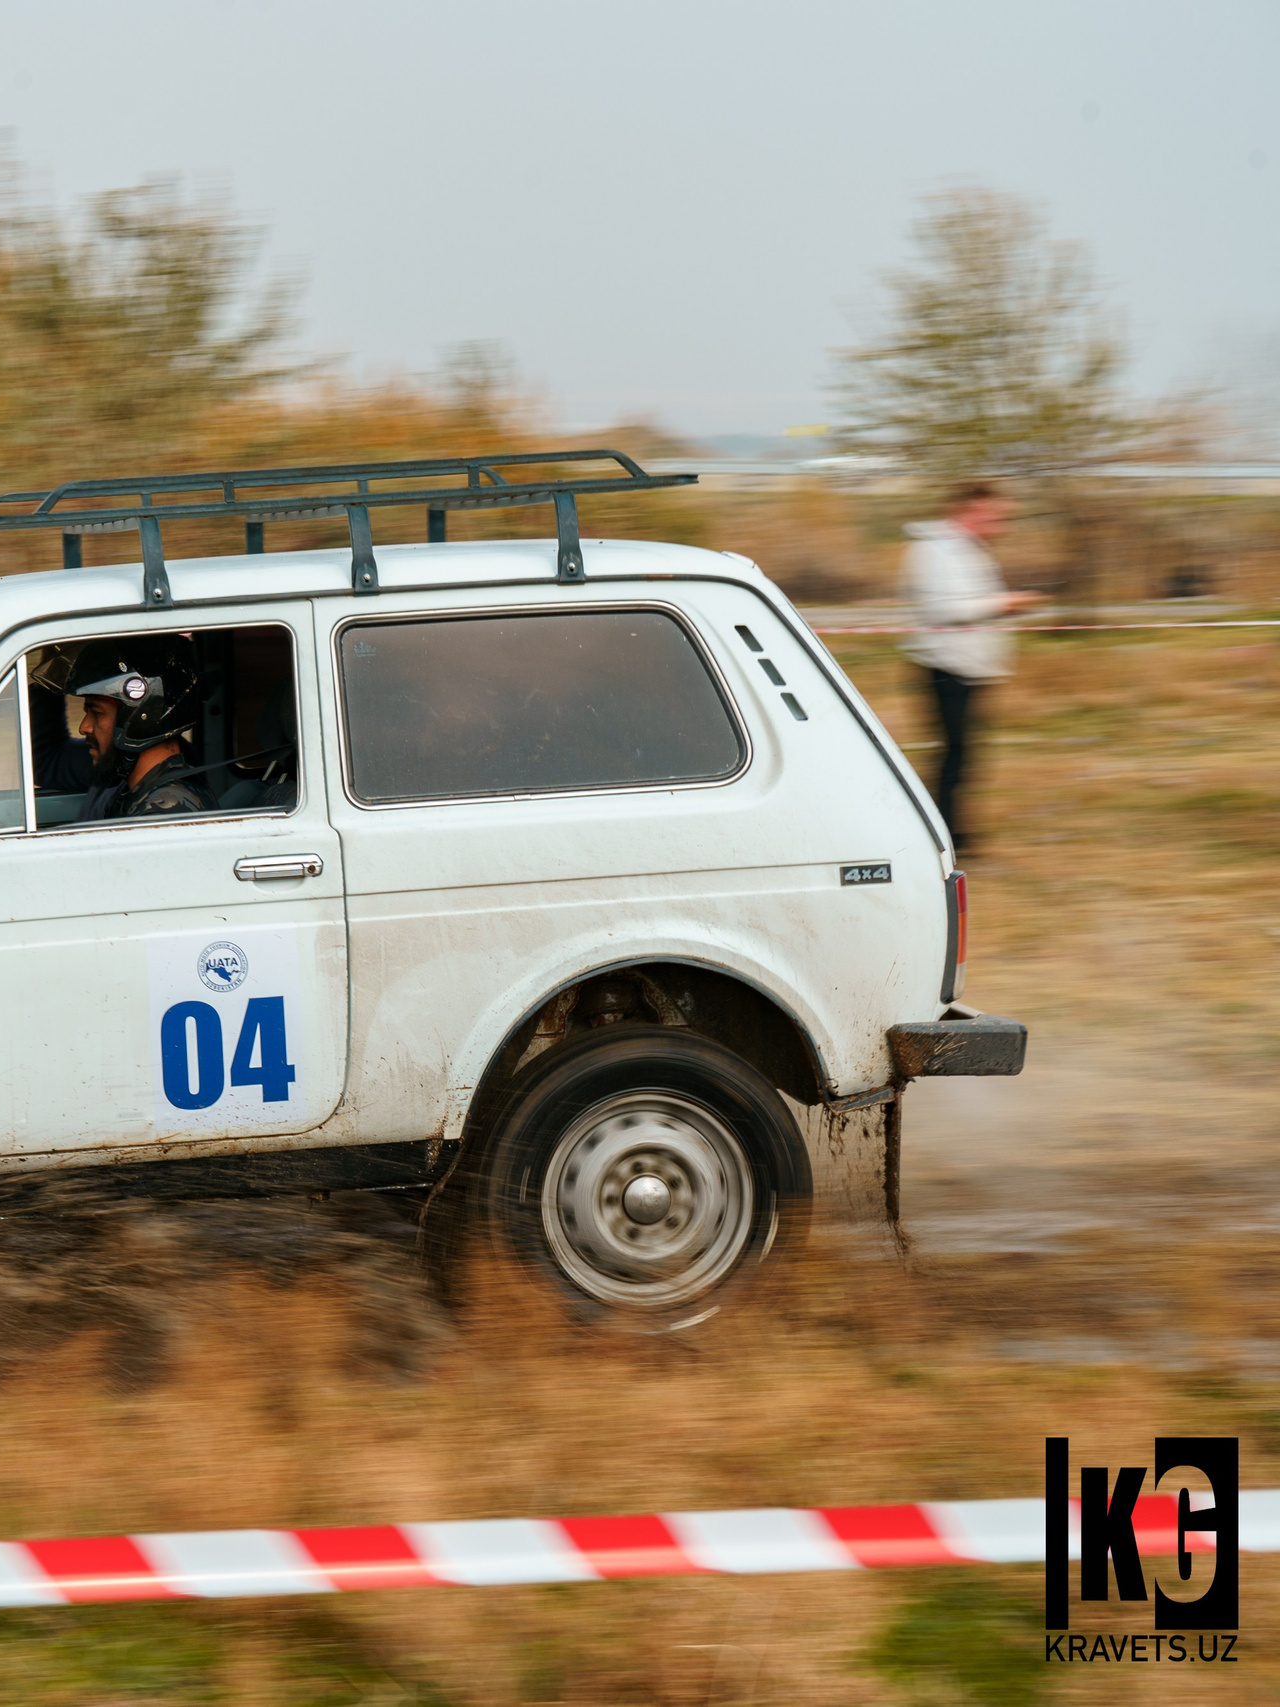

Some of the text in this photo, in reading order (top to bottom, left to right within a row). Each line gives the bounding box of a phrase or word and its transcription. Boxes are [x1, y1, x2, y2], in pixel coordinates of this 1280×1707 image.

[844, 866, 890, 882] 4x4
[208, 957, 239, 968] UATA
[206, 977, 243, 991] UZBEKISTAN
[161, 996, 296, 1110] 04
